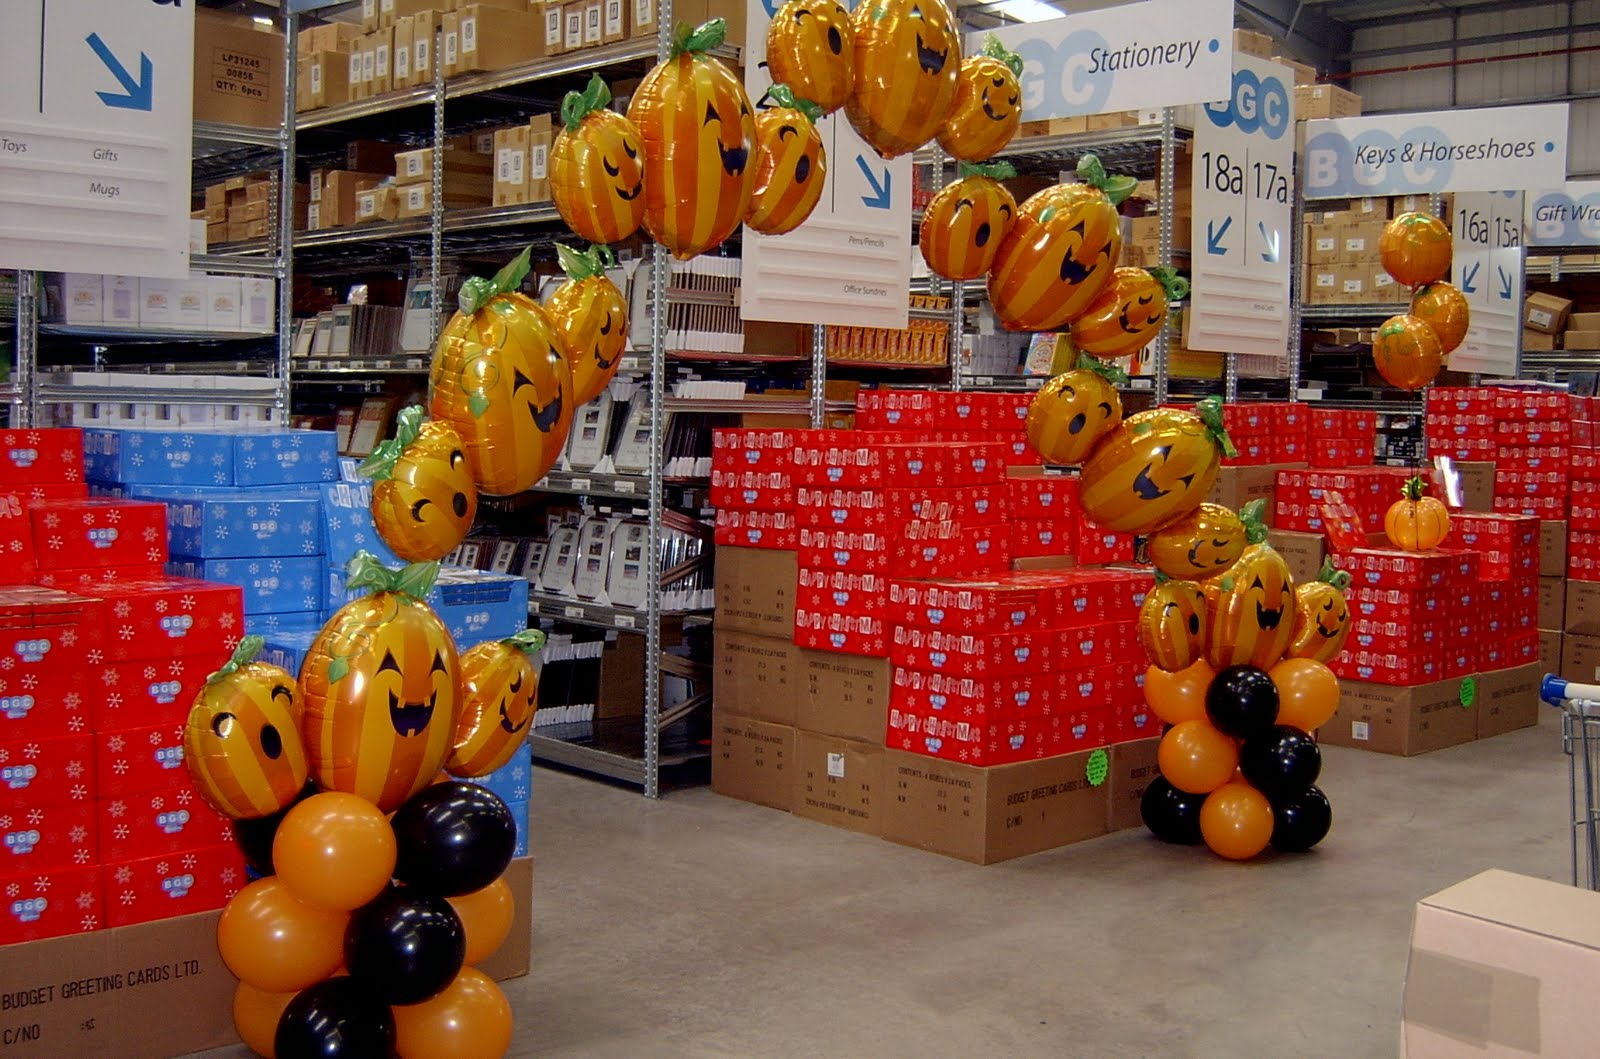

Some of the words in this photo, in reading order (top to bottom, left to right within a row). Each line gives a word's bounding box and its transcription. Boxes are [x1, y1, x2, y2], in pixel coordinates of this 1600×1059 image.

[1088, 40, 1200, 74] Stationery
[1, 139, 27, 153] Toys
[1354, 145, 1396, 169] Keys
[1400, 142, 1415, 162] &
[1420, 137, 1536, 162] Horseshoes
[93, 148, 119, 162] Gifts
[1201, 152, 1243, 195] 18a
[89, 182, 121, 197] Mugs
[1253, 162, 1288, 204] 17a
[1535, 204, 1568, 222] Gift
[1459, 209, 1488, 244] 16a
[1495, 216, 1519, 248] 15a
[843, 284, 862, 295] Office
[862, 285, 888, 297] Sundries
[89, 529, 117, 540] BGC
[162, 616, 192, 628] BGC
[17, 641, 50, 652] BGC
[151, 682, 181, 694] BGC
[1006, 790, 1030, 807] BUDGET
[1030, 785, 1058, 801] GREETING
[1059, 780, 1078, 794] CARDS
[159, 811, 189, 825] BGC
[7, 832, 39, 845] BGC
[164, 876, 194, 889] BGC
[13, 898, 46, 912] BGC
[2, 985, 55, 1010] BUDGET
[61, 974, 123, 1000] GREETING
[127, 965, 170, 987] CARDS
[175, 959, 202, 979] LTD.
[3, 1024, 41, 1046] C/NO
